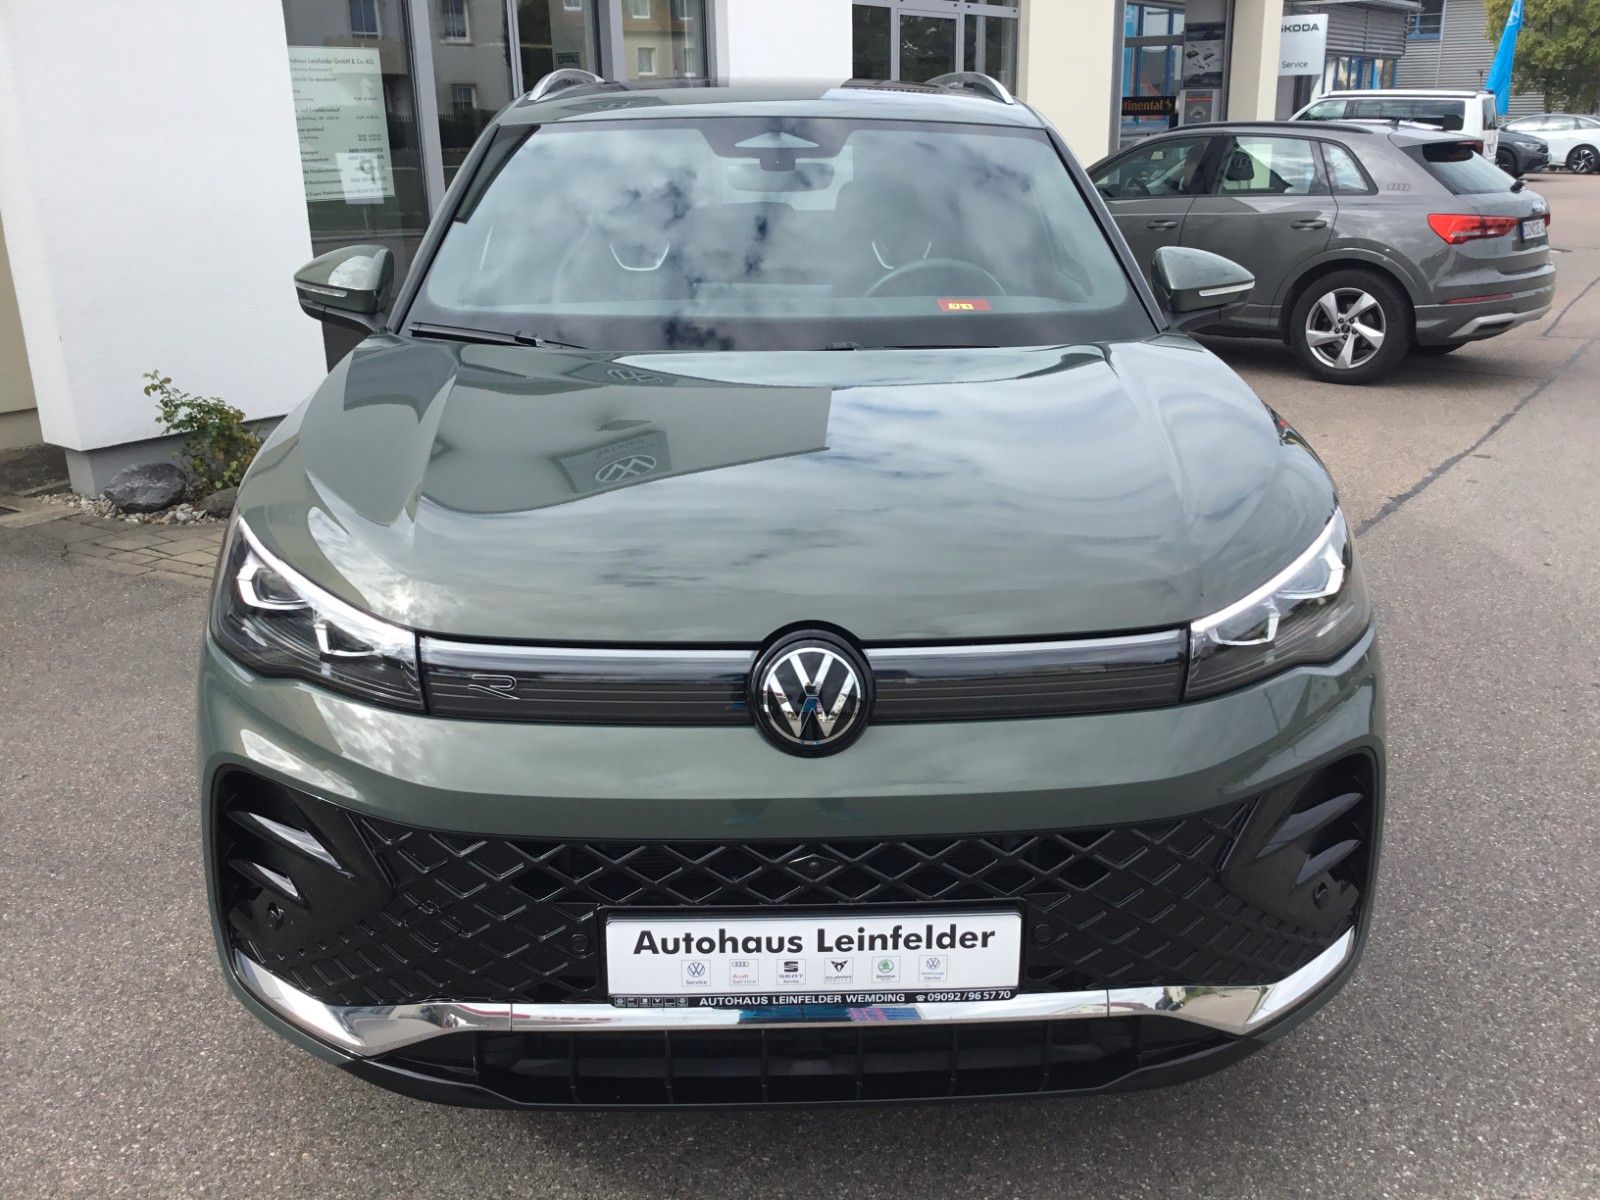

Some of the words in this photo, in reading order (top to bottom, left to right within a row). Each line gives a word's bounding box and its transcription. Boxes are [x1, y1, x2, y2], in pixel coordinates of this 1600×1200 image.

[1282, 61, 1308, 69] Service
[633, 928, 803, 955] Autohaus
[817, 923, 996, 953] Leinfelder
[699, 996, 769, 1006] AUTOHAUS
[772, 994, 842, 1005] LEINFELDER
[845, 993, 906, 1004] WEMDING
